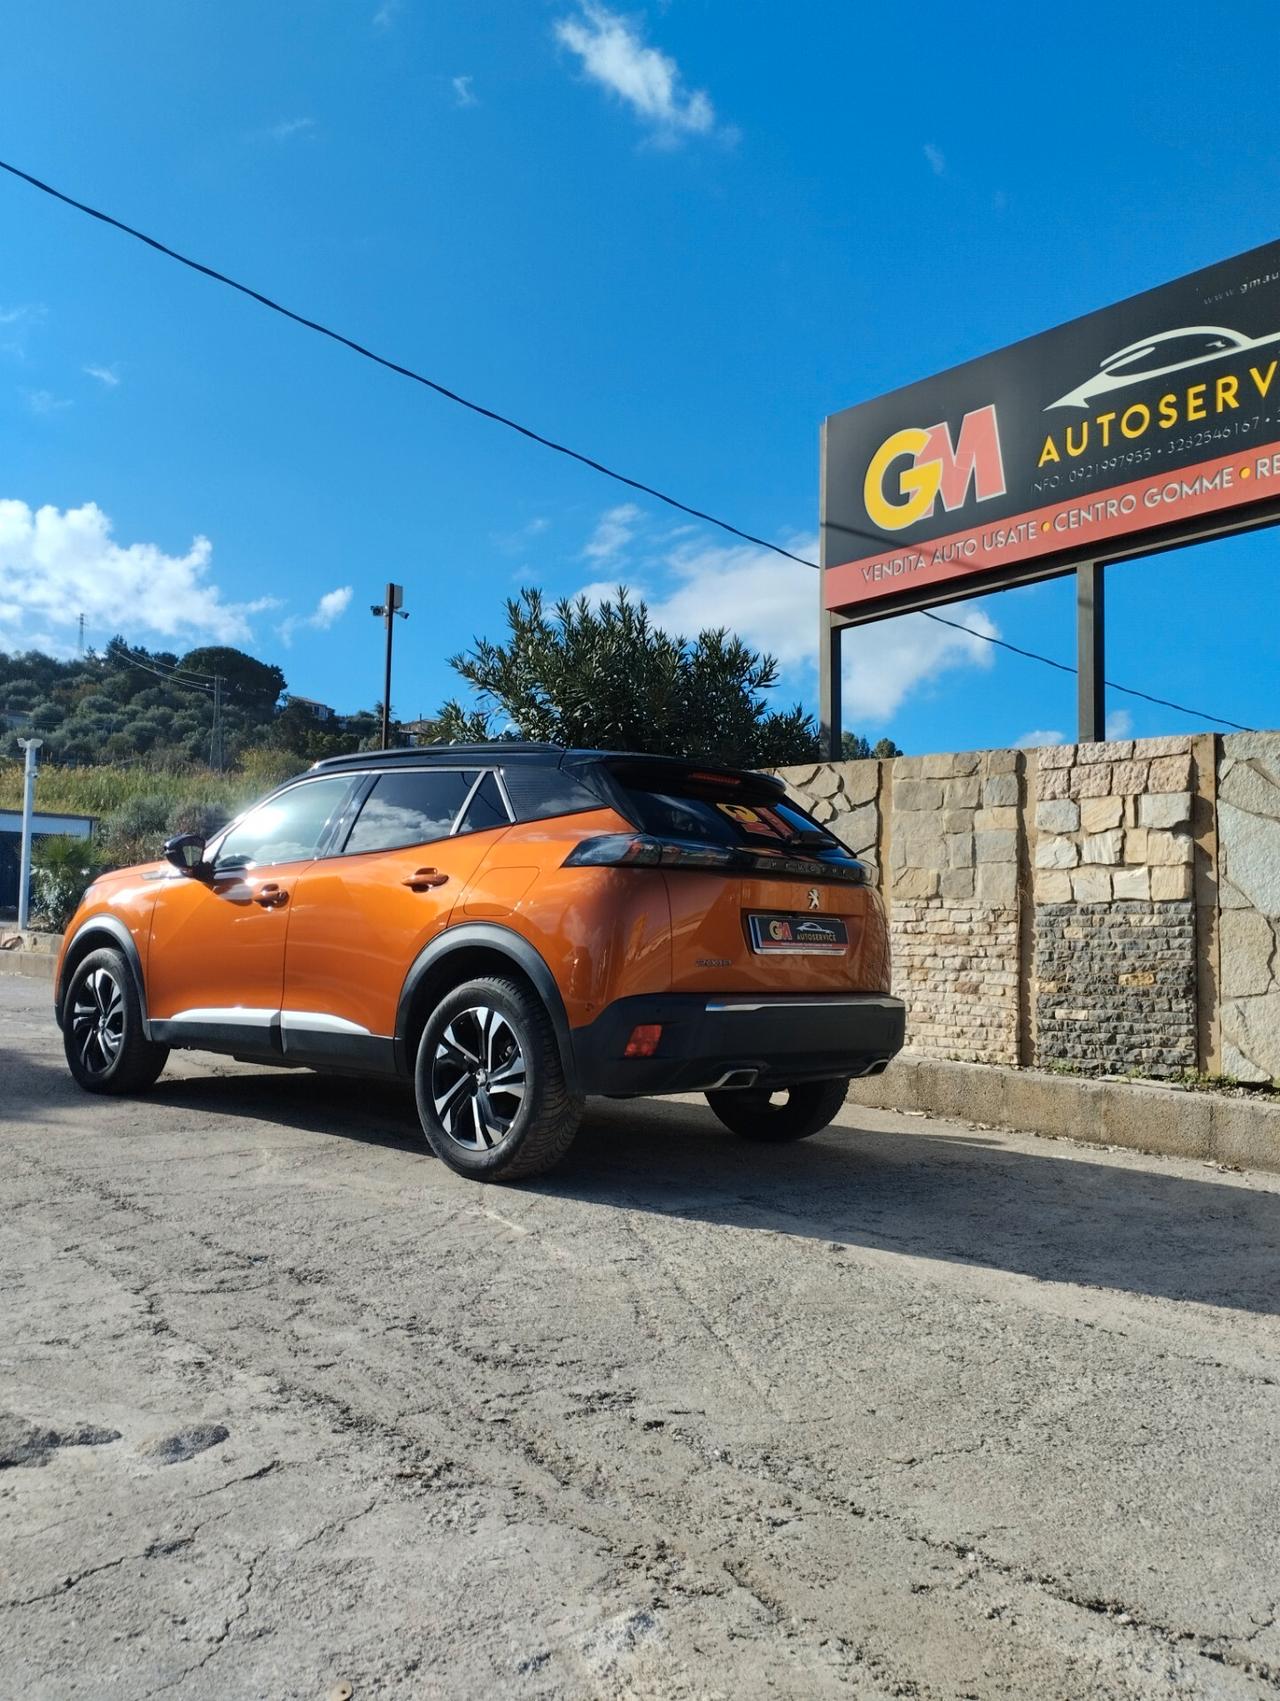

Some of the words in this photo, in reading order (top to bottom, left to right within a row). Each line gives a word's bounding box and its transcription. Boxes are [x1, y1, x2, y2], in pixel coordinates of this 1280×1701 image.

[864, 403, 1007, 531] GM
[1037, 360, 1278, 468] AUTOSERV
[861, 554, 926, 583] VENDITA
[931, 538, 977, 566] AUTO
[982, 521, 1038, 551] USATE
[1053, 494, 1137, 533] CENTRO
[1143, 467, 1234, 509] GOMME
[769, 919, 792, 940] GM
